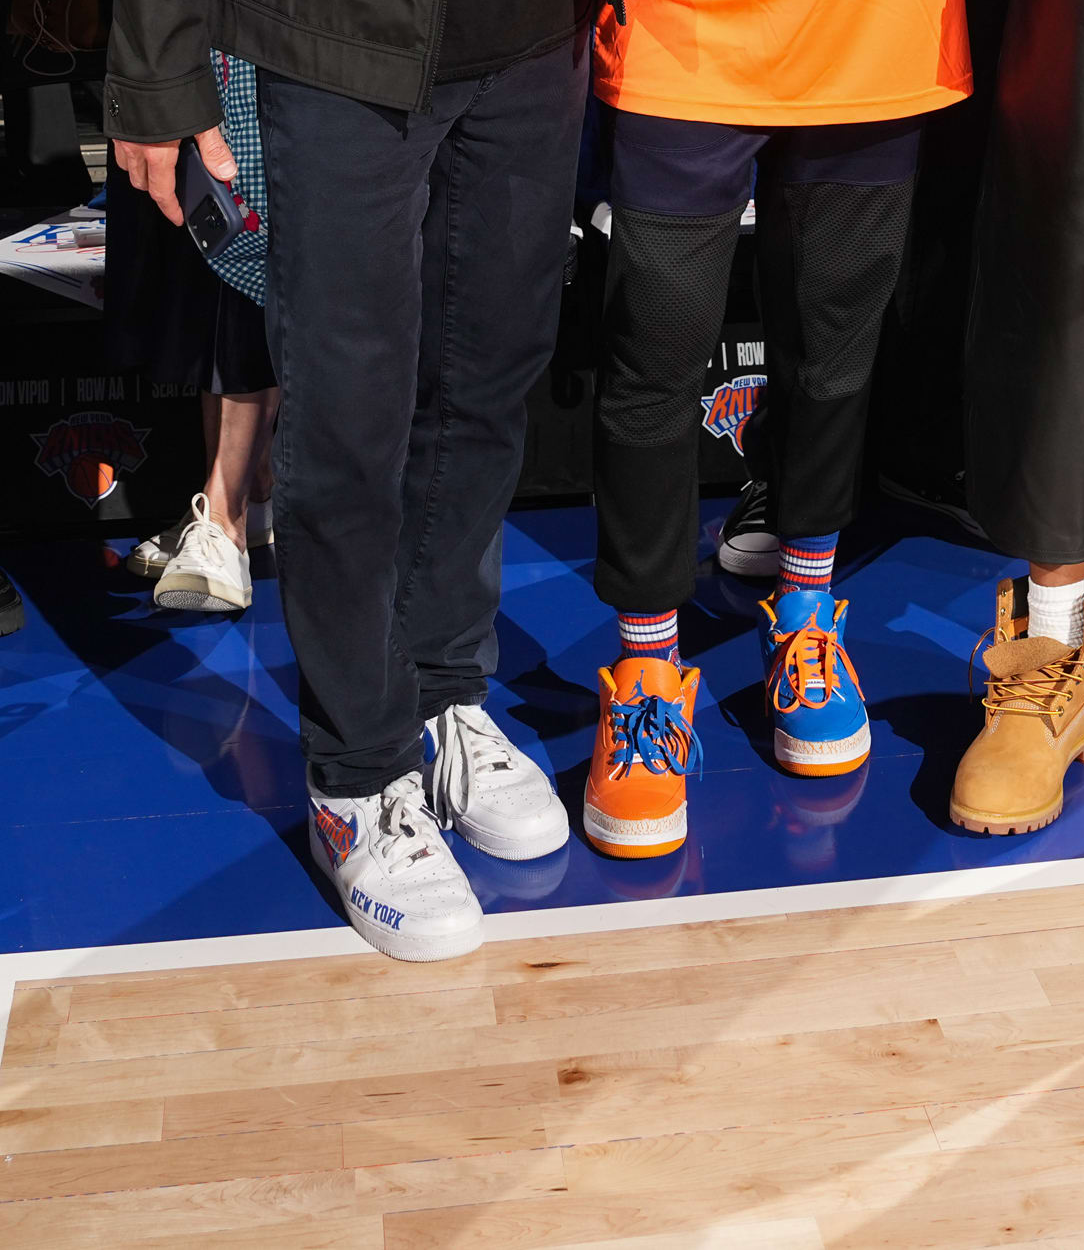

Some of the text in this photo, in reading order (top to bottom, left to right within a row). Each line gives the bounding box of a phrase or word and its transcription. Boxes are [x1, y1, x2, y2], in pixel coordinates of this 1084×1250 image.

[736, 341, 765, 367] ROW
[76, 376, 106, 402] ROW
[733, 377, 751, 389] NEW
[706, 386, 760, 426] KNI
[350, 885, 405, 931] NEW YORK
